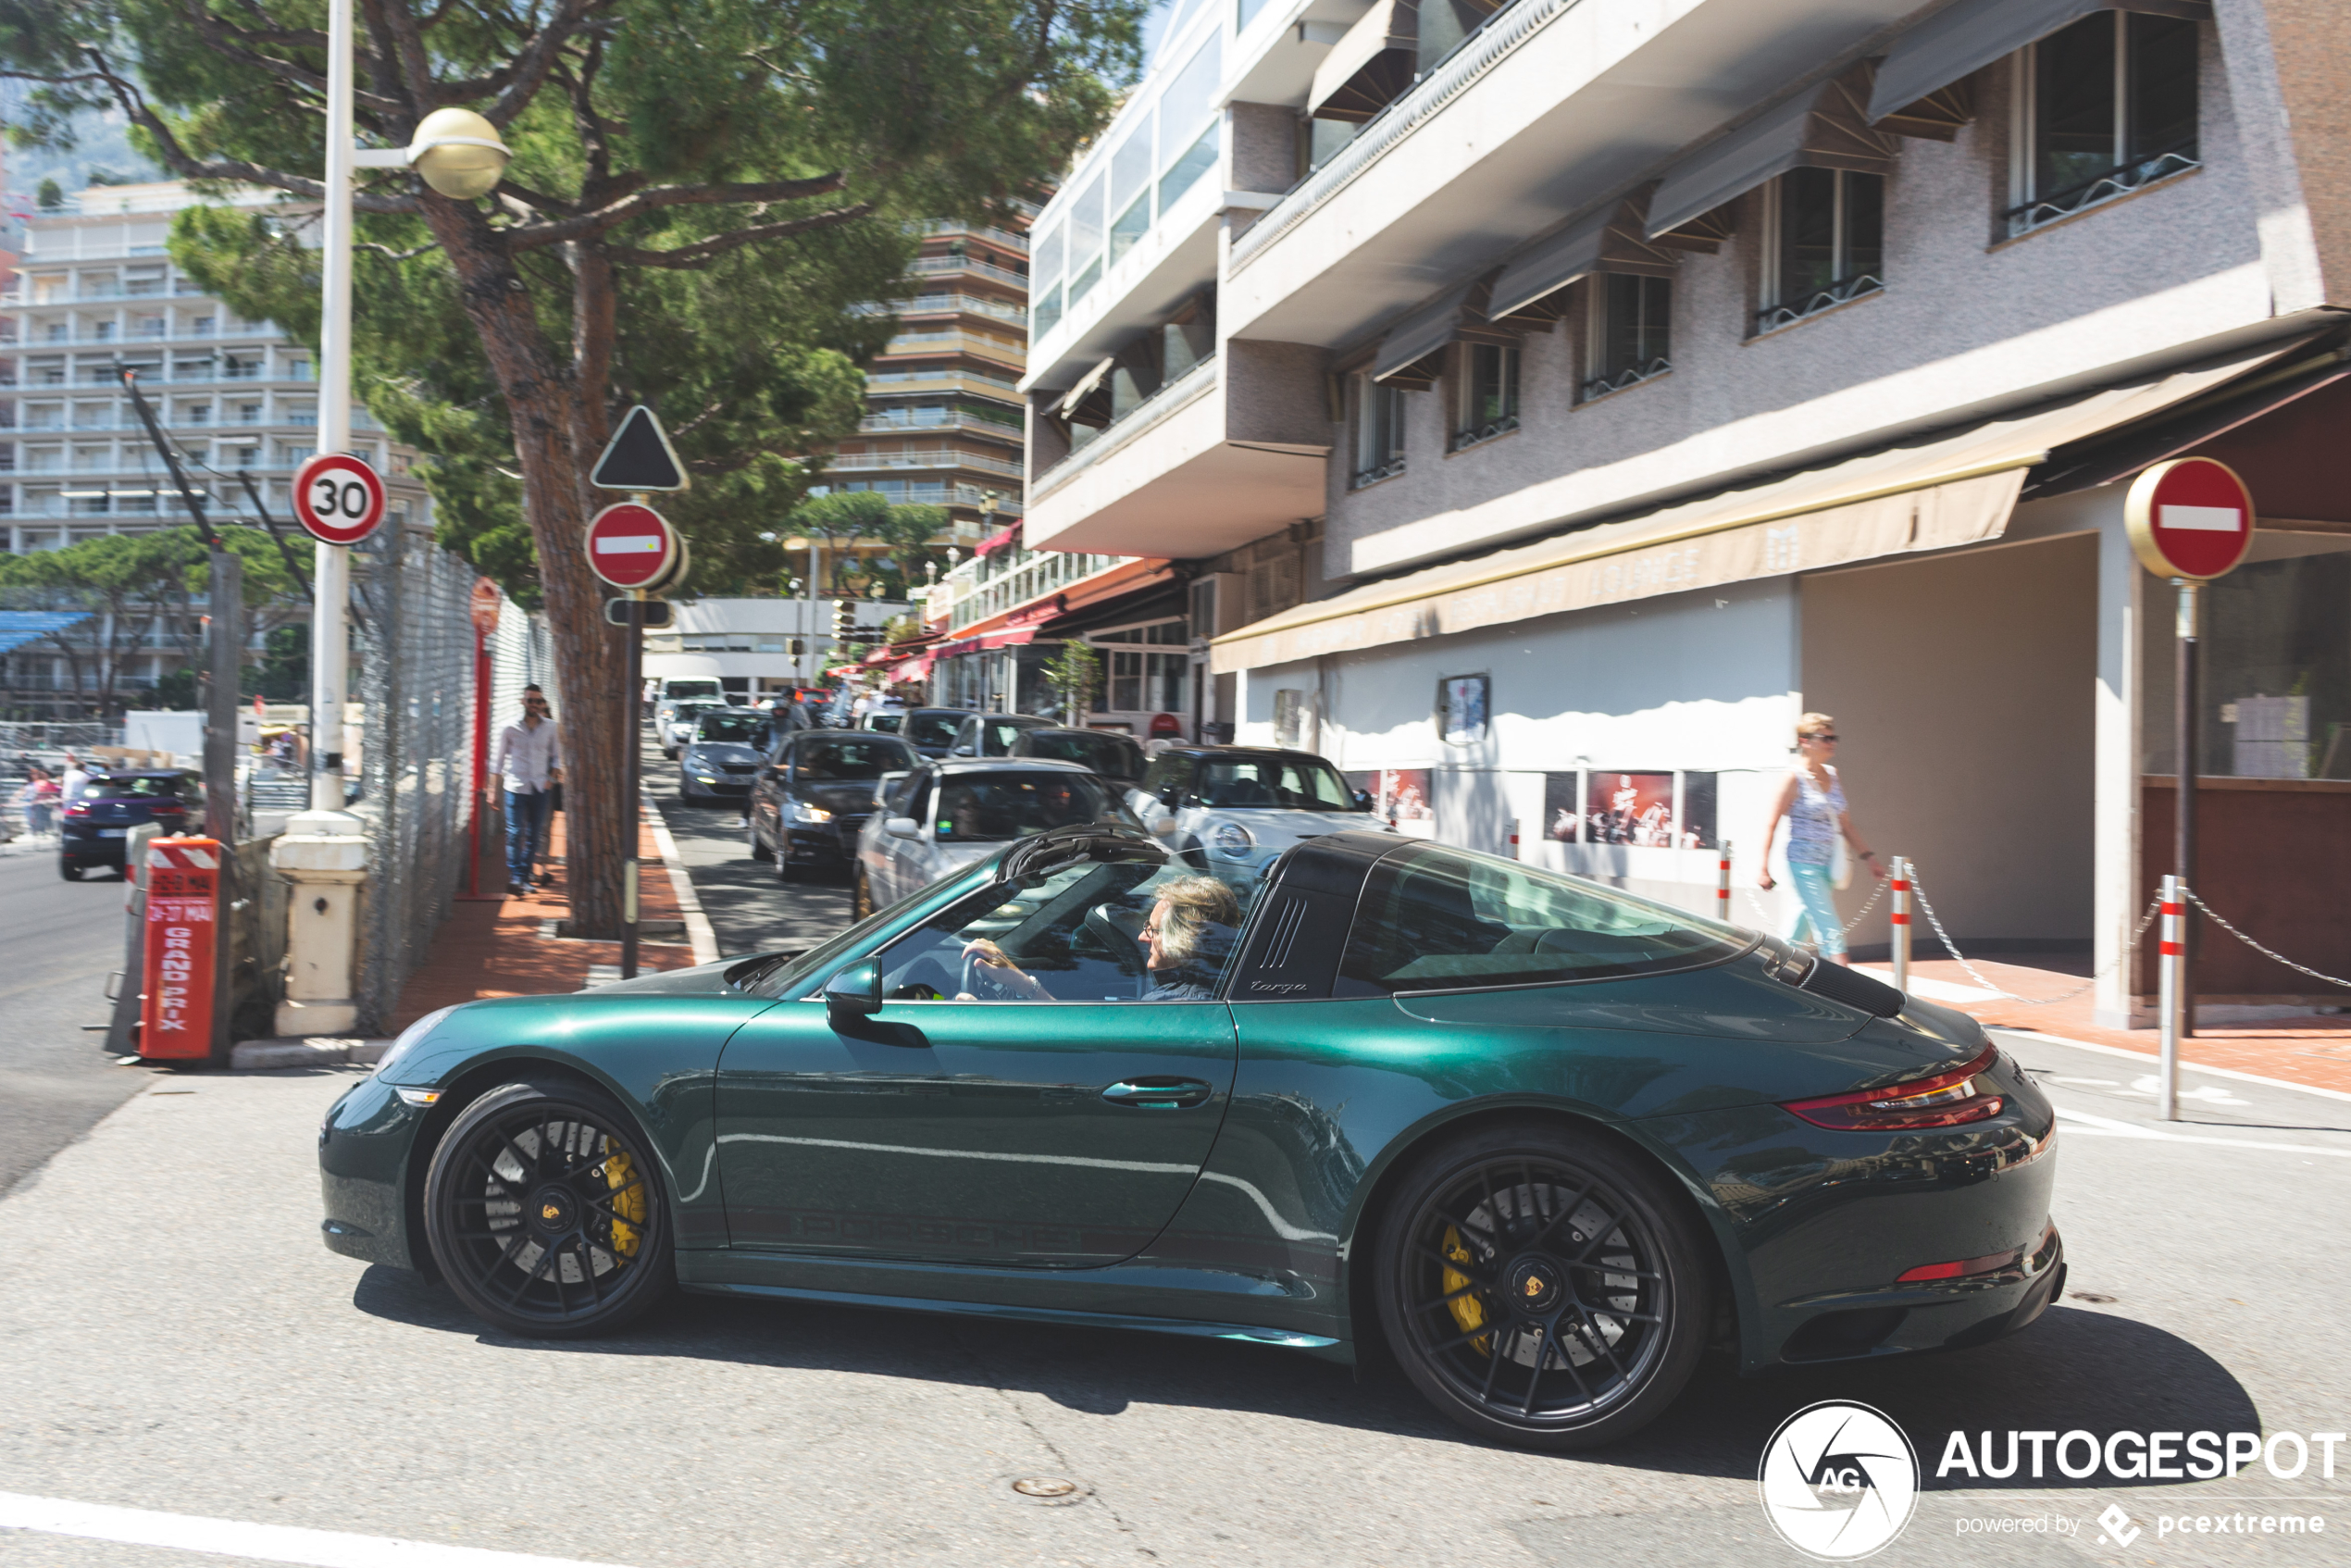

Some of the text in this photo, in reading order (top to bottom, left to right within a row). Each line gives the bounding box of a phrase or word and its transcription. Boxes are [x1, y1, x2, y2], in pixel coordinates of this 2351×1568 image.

[315, 479, 367, 518] 30
[1590, 548, 1701, 597] LOUNGE
[185, 905, 214, 923] MAI
[161, 927, 193, 981] GRAND
[158, 987, 189, 1031] PRIX
[802, 1214, 1071, 1250] PORSCHE
